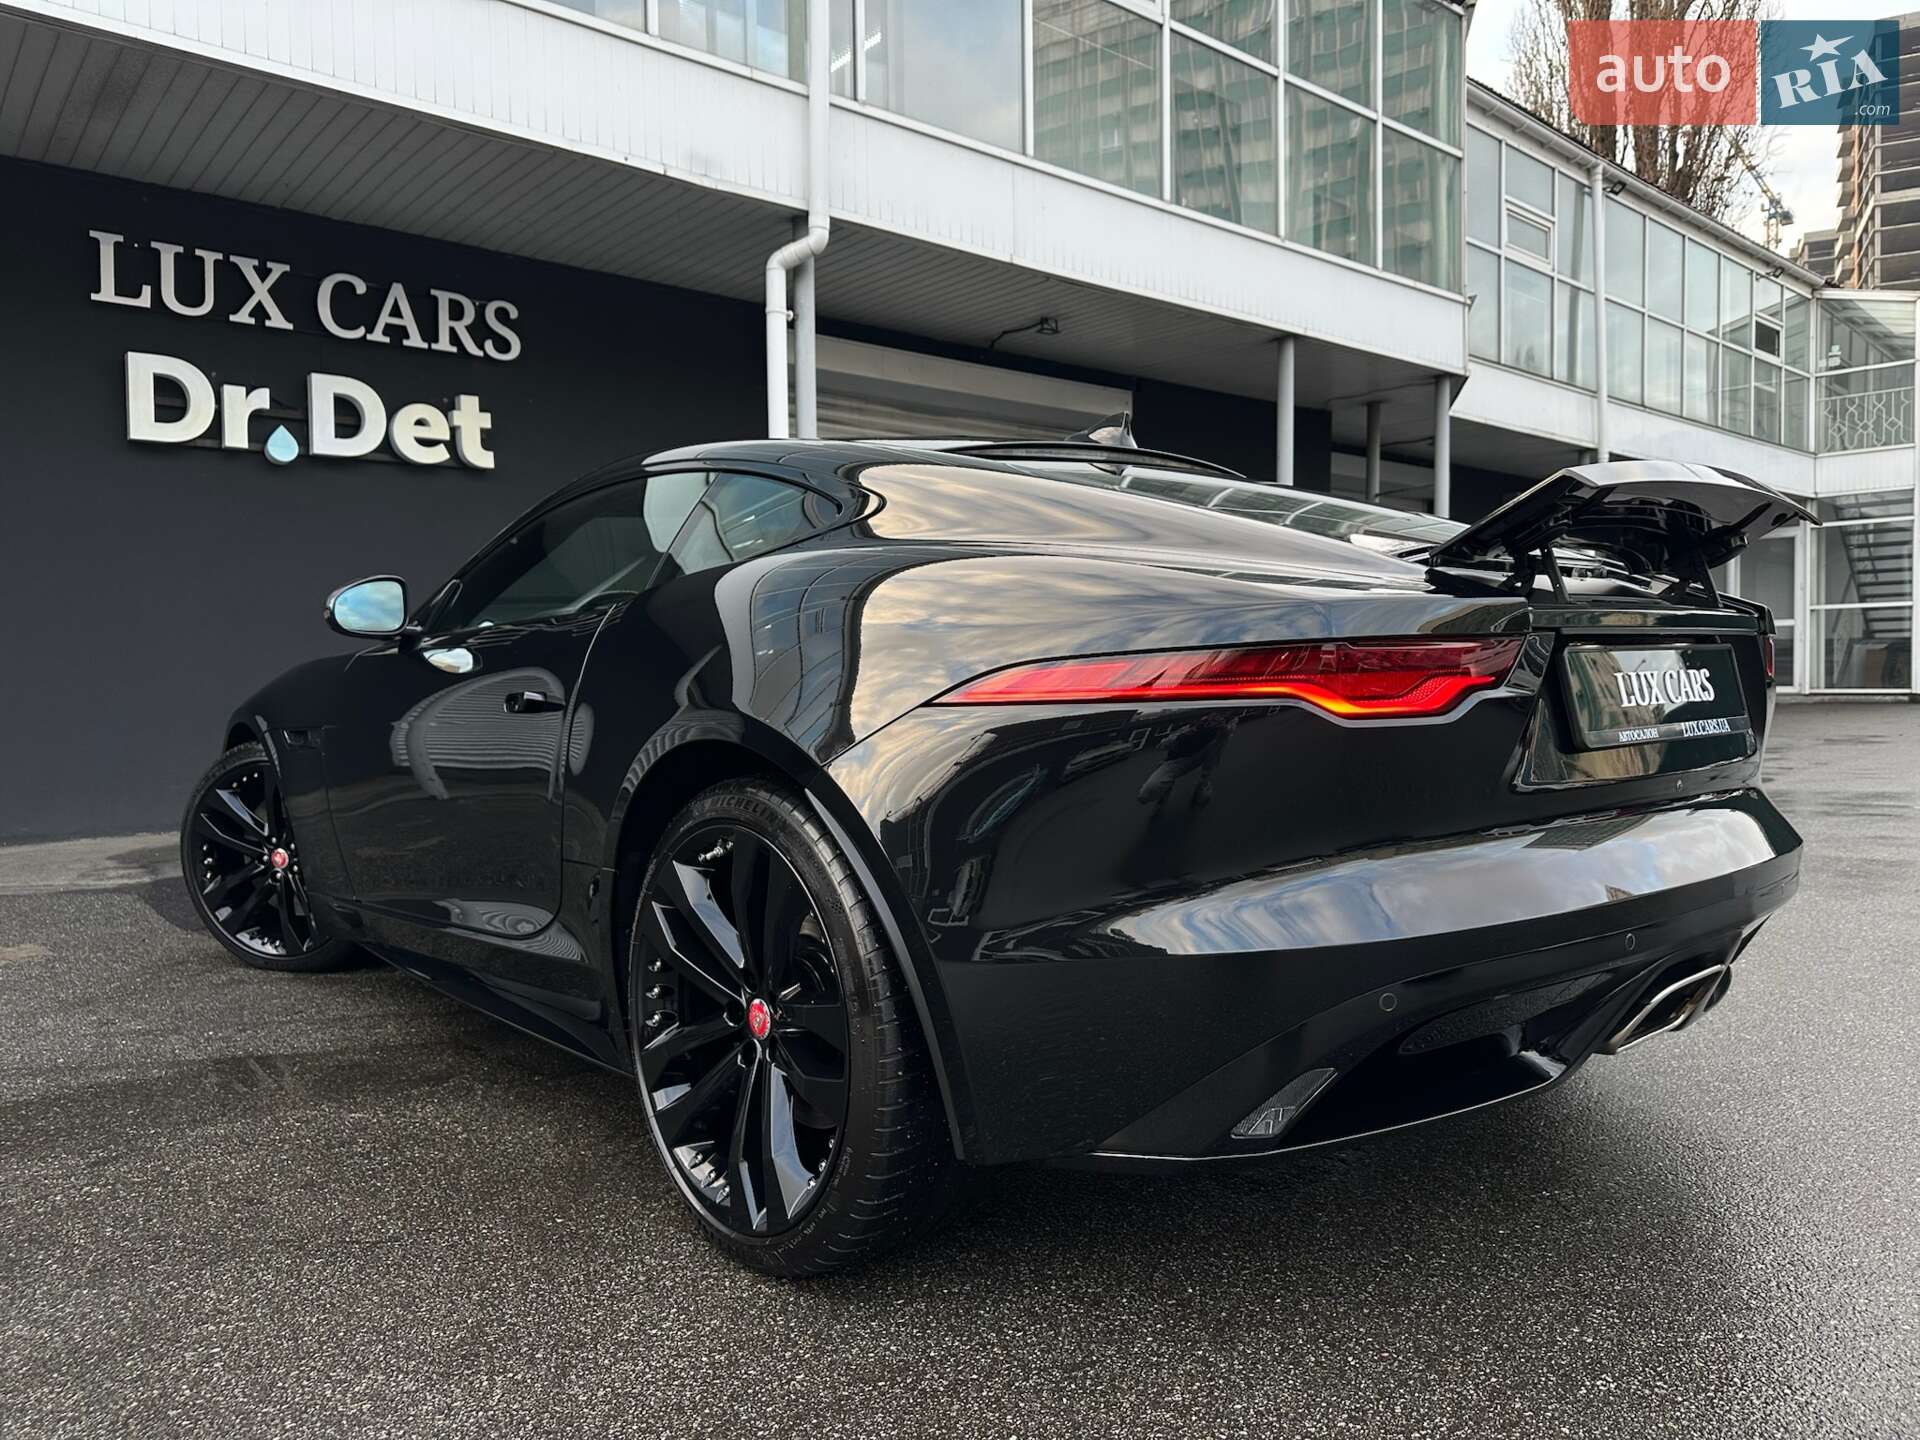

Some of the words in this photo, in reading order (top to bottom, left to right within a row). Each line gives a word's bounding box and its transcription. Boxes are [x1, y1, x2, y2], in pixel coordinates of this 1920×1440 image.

[89, 229, 294, 330] LUX
[317, 273, 522, 361] CARS
[1614, 670, 1665, 708] LUX
[1664, 668, 1715, 704] CARS
[1619, 728, 1659, 742] АВТОСАЛОН
